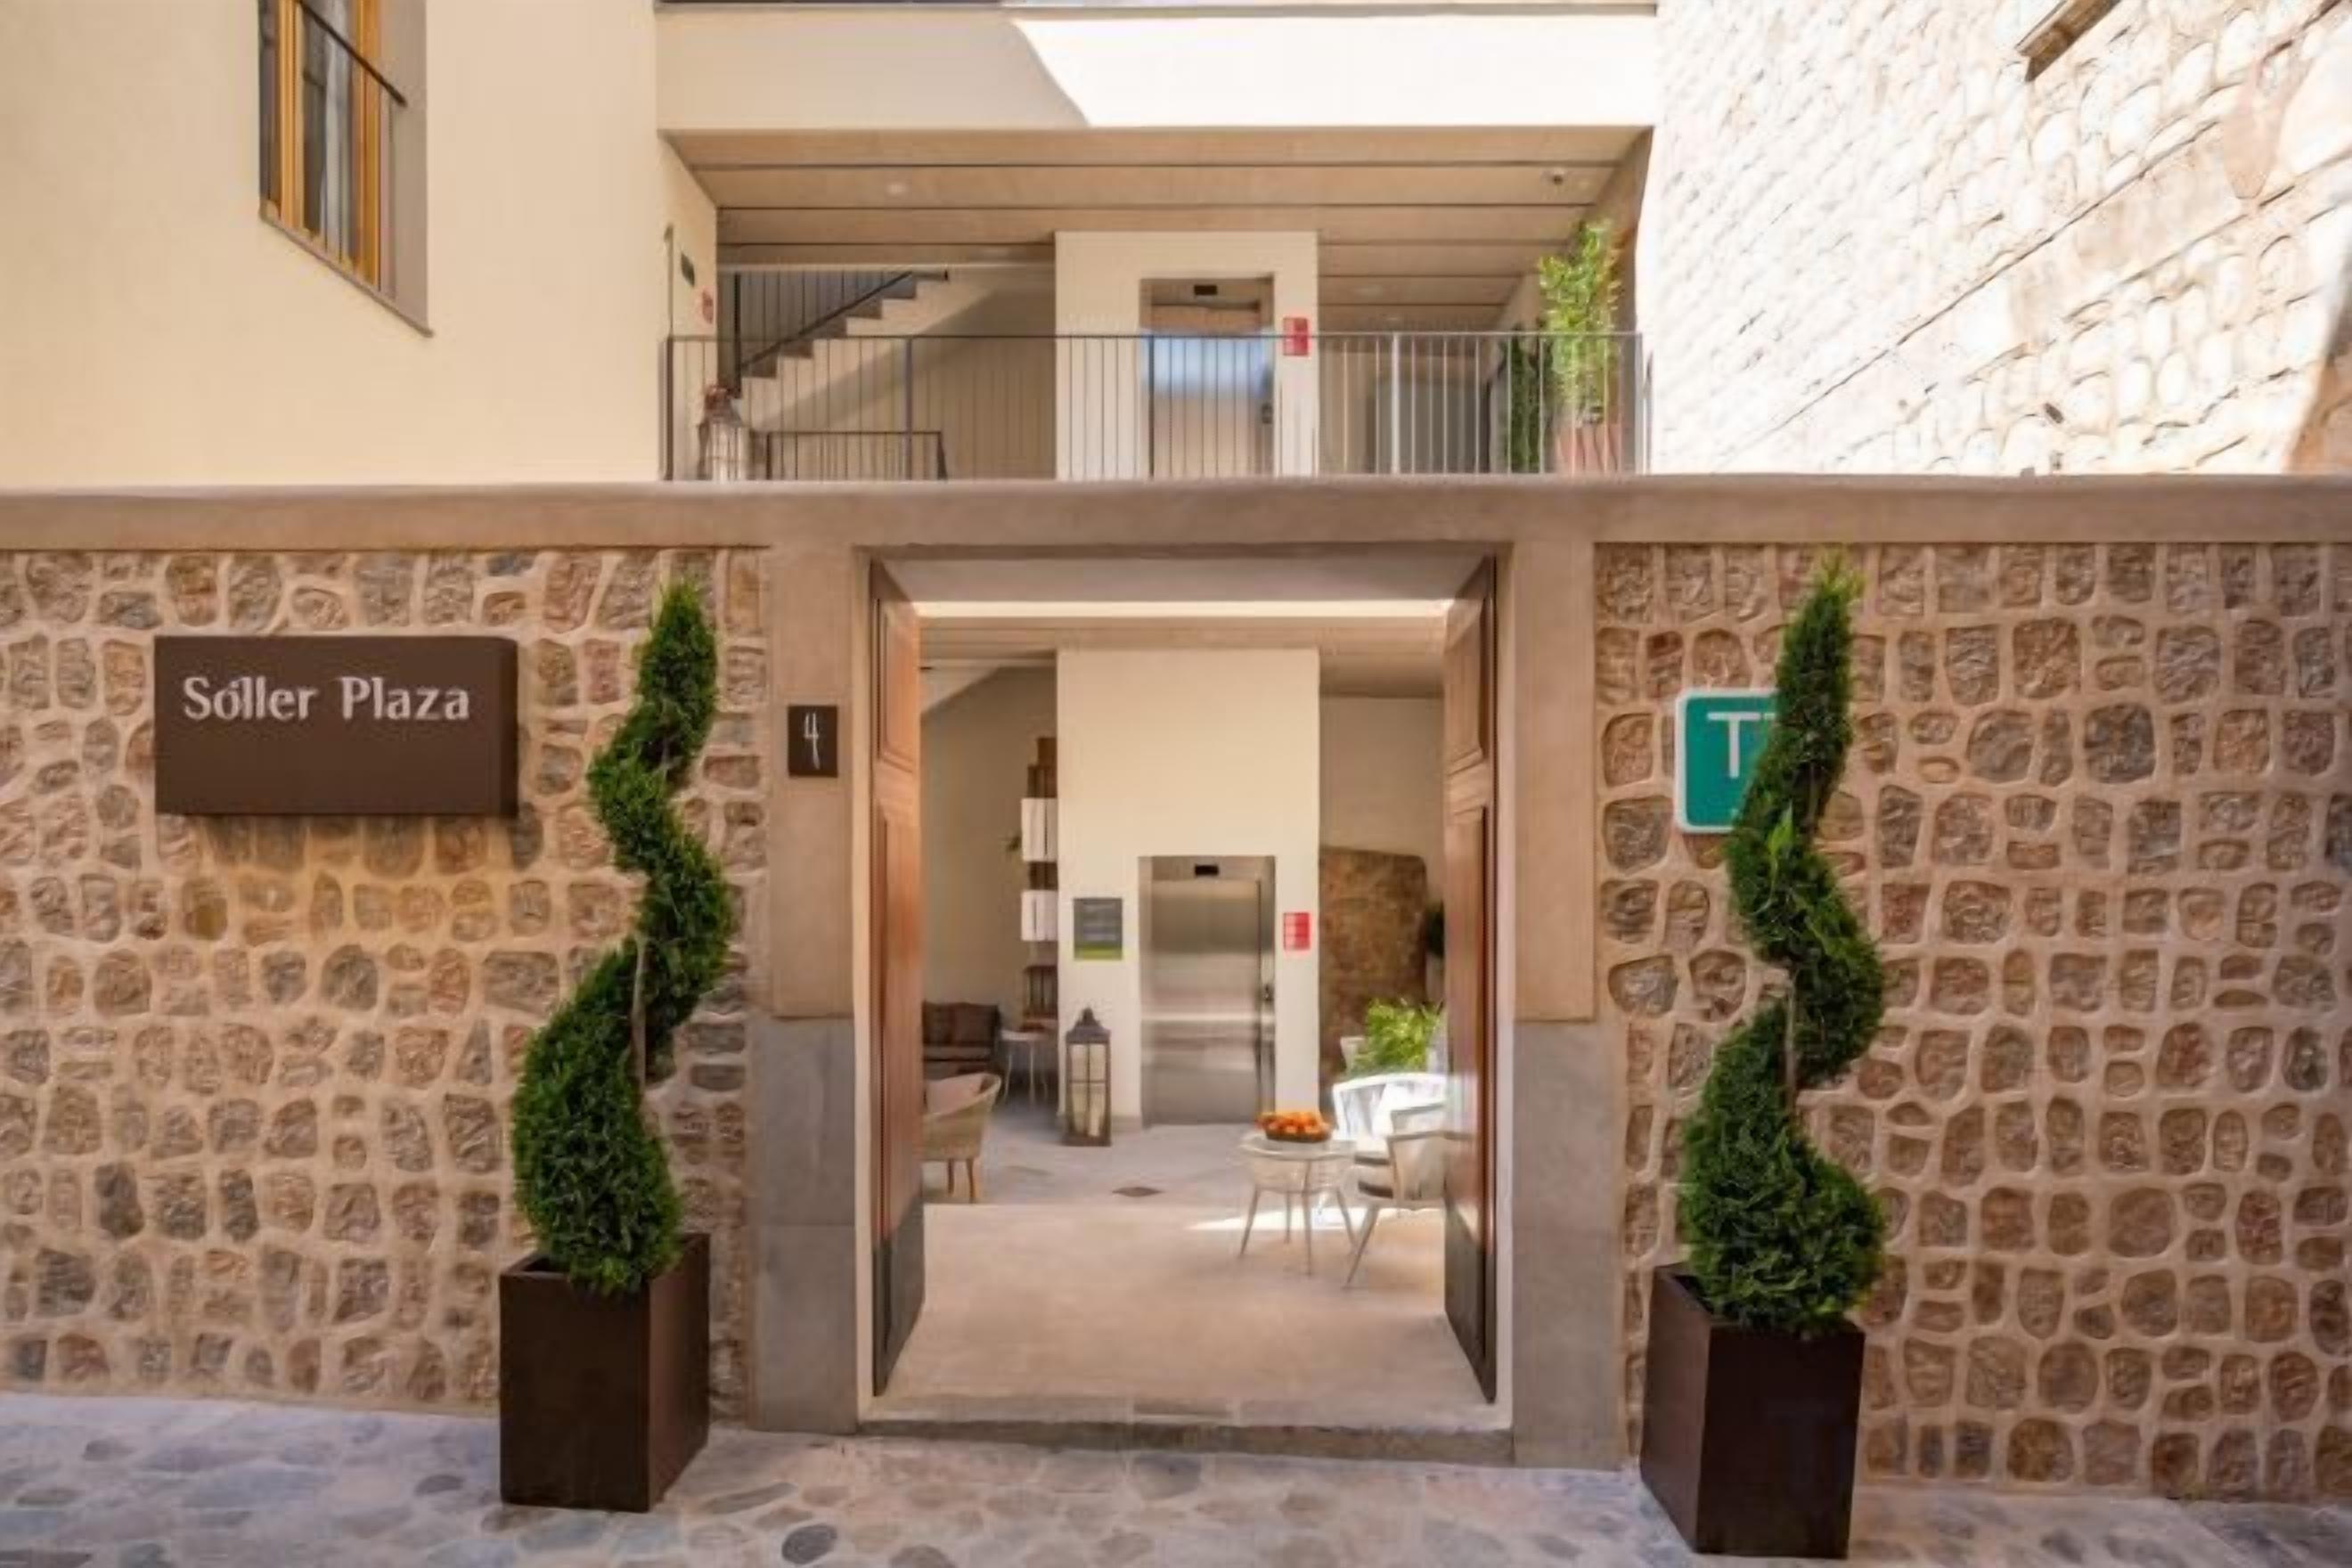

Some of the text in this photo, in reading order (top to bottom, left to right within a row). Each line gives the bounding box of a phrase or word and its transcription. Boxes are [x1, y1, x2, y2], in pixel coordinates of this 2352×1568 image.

[183, 675, 470, 722] Sóller Plaza
[804, 712, 821, 770] 4
[1707, 712, 1776, 779] T
